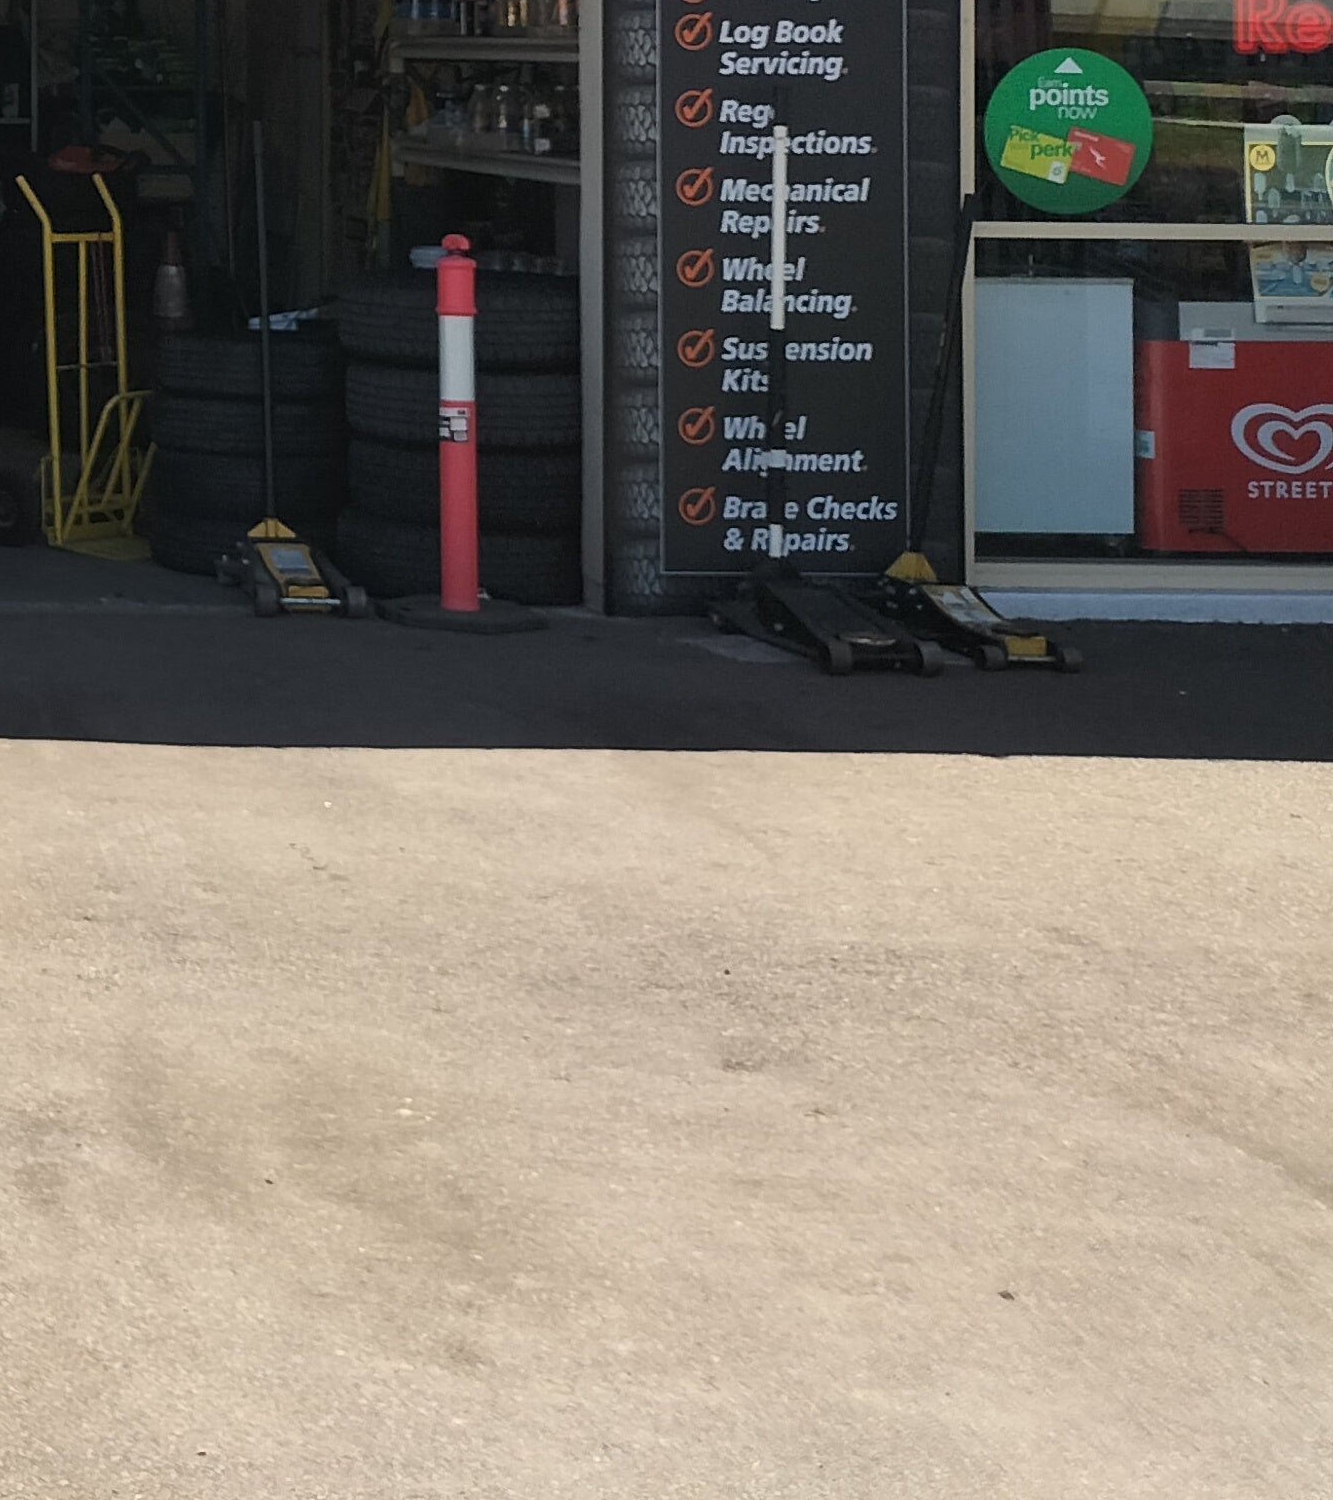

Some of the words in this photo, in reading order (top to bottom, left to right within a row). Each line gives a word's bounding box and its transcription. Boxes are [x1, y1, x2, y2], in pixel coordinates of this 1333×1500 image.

[719, 20, 771, 50] Log
[774, 18, 845, 44] Book
[1029, 83, 1109, 111] points
[1058, 106, 1097, 120] now
[720, 209, 826, 239] Repirs.
[720, 337, 873, 362] Susension
[723, 416, 808, 441] Whel
[1247, 480, 1333, 499] STREET
[722, 496, 800, 520] Brae
[806, 495, 899, 520] Checks
[723, 527, 745, 551] &
[750, 528, 855, 558] Rpairs.
